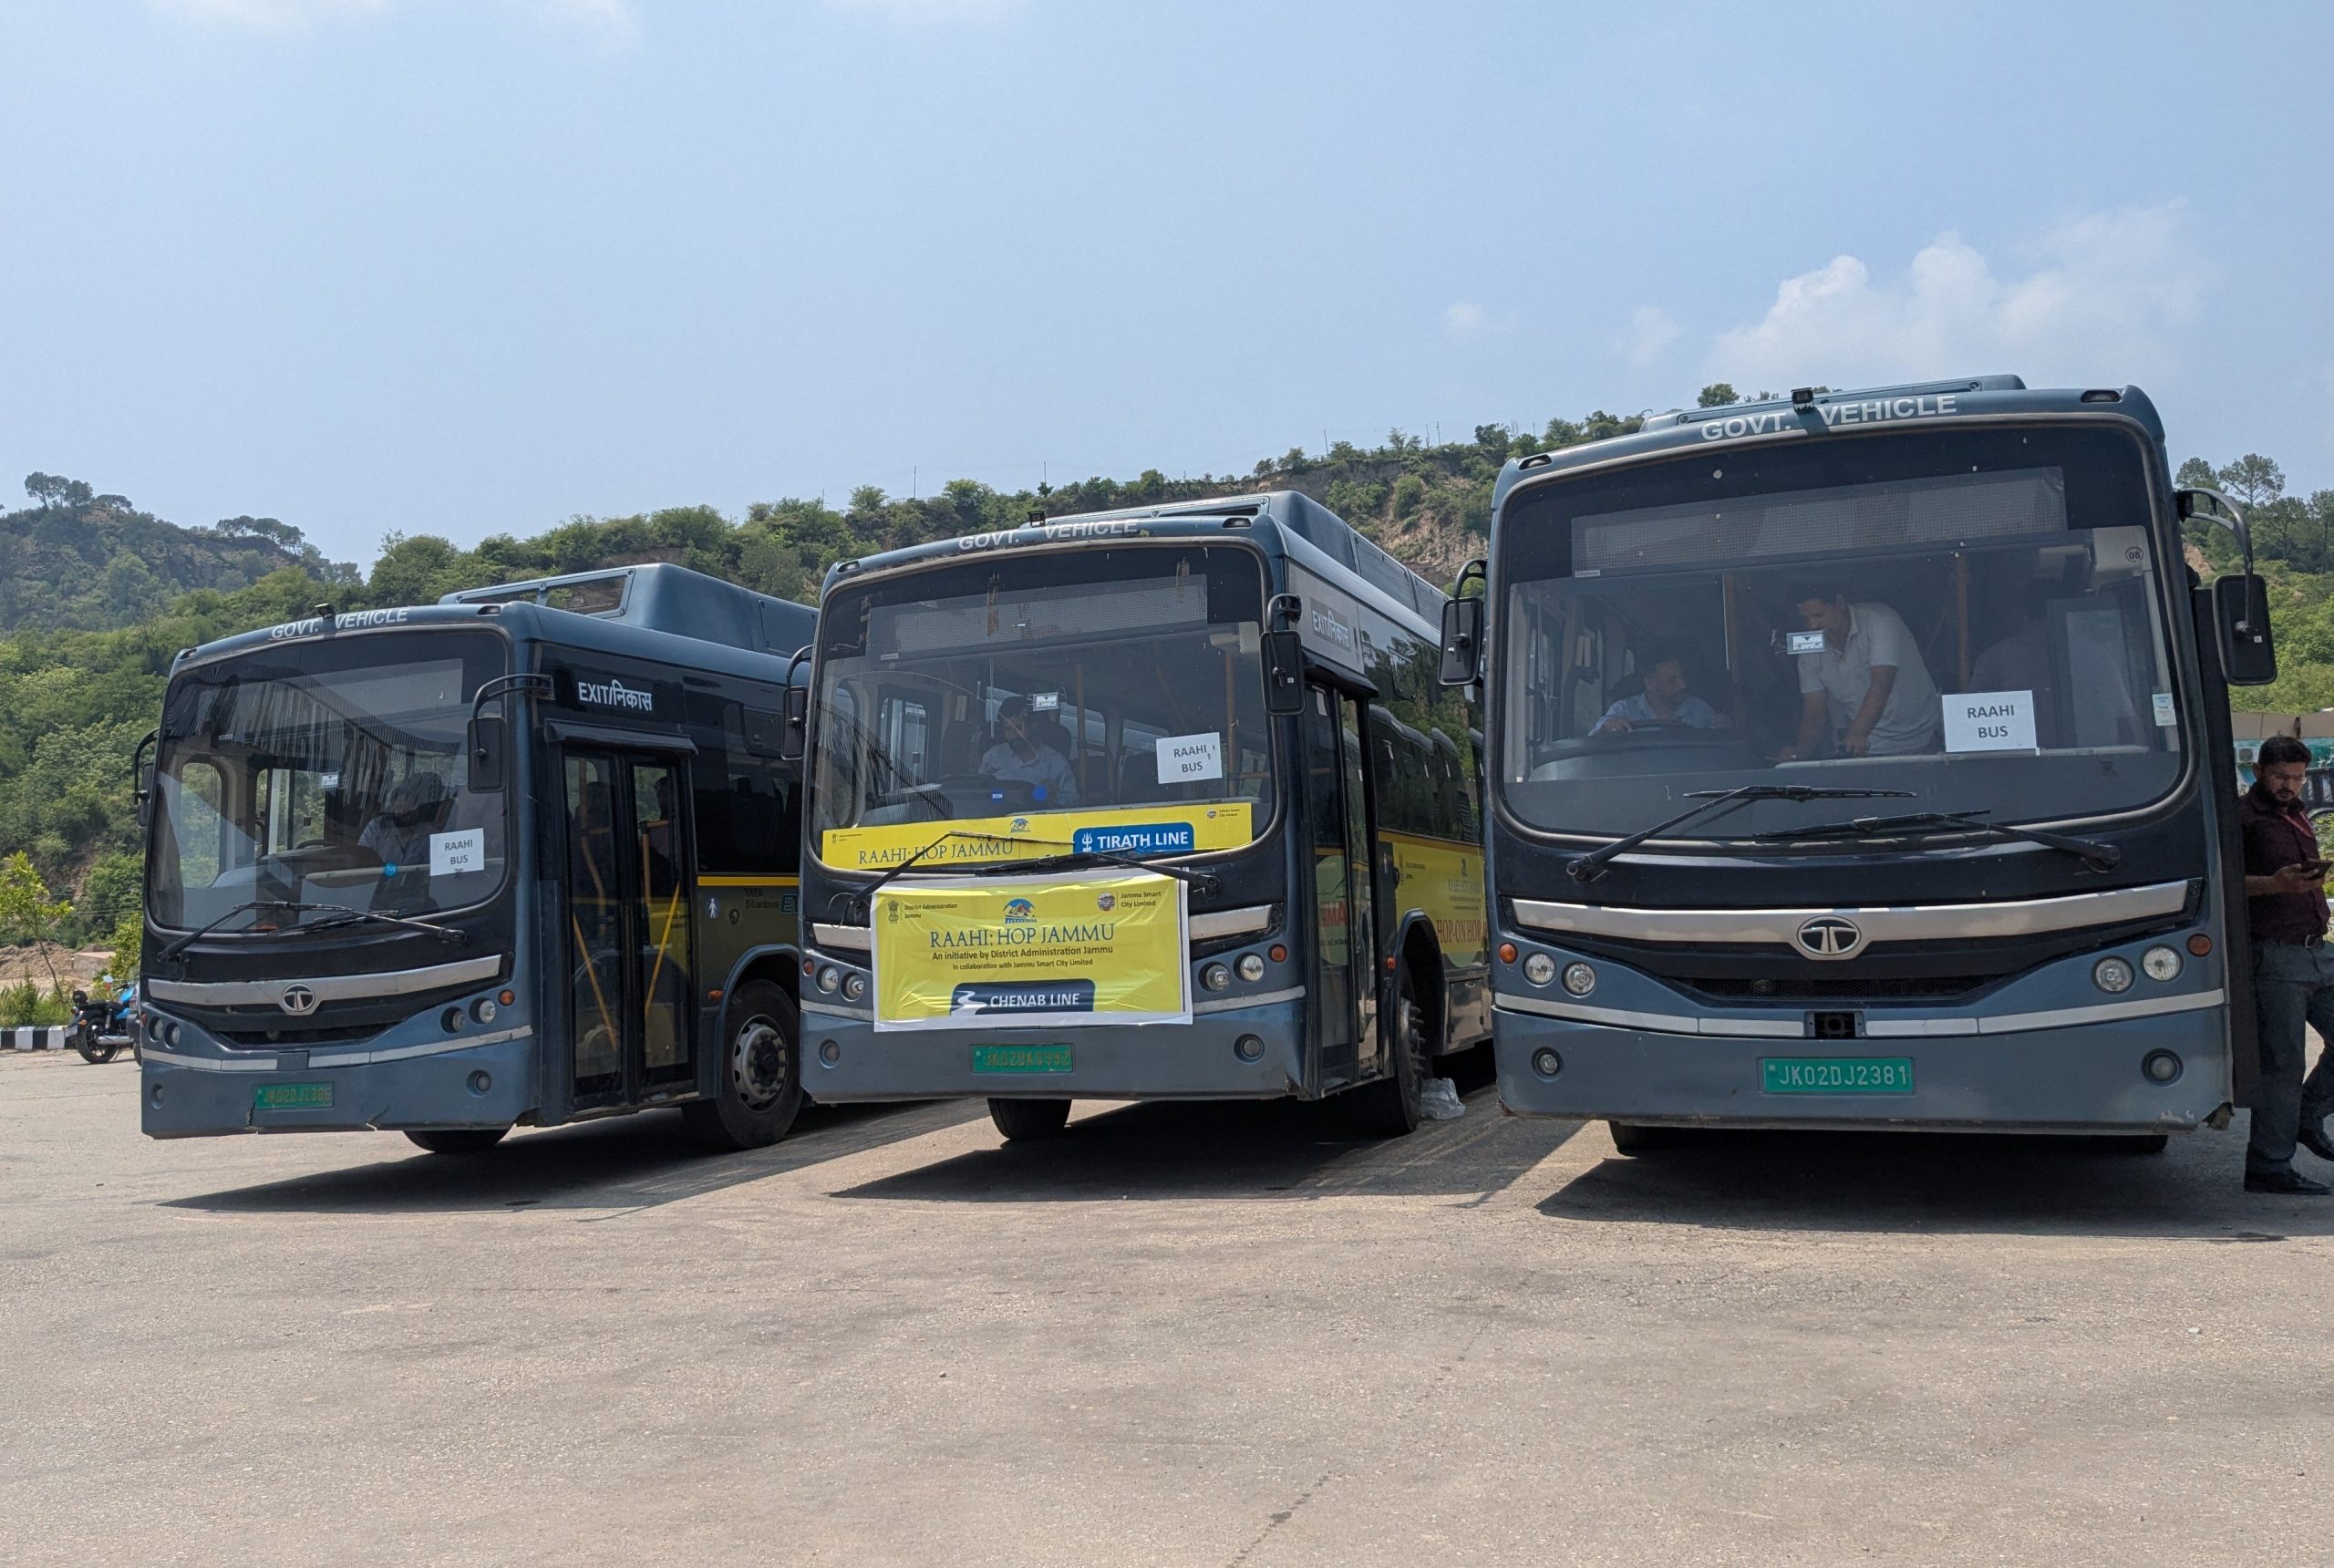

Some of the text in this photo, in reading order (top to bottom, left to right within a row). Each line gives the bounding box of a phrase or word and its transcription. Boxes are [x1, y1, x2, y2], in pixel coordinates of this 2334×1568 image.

[1700, 395, 1957, 440] GOVT. VEHICLE
[958, 519, 1140, 551] GOVT. VEHICLE
[272, 607, 410, 639] GOVT. VEHICLE
[1967, 704, 2015, 718] RAAHI
[1978, 725, 2009, 738] BUS
[1173, 744, 1207, 758] RAAHI
[1182, 761, 1203, 773] BUS
[444, 839, 473, 851] RAAHI
[1097, 830, 1189, 849] TIRATH LINE
[914, 844, 947, 860] HOP
[951, 840, 1013, 858] JAMMU
[449, 855, 469, 866] BUS
[929, 923, 1116, 948] RAAHI: HOP JAMMU
[932, 946, 1113, 961] An initiative by District Administration Jammu
[960, 962, 997, 970] collaboration
[998, 961, 1012, 969] with
[1056, 959, 1069, 967] City
[1069, 958, 1094, 966] Limited
[990, 992, 1080, 1007] CHENAB LINE
[1779, 1065, 1907, 1087] JK02DJ2381
